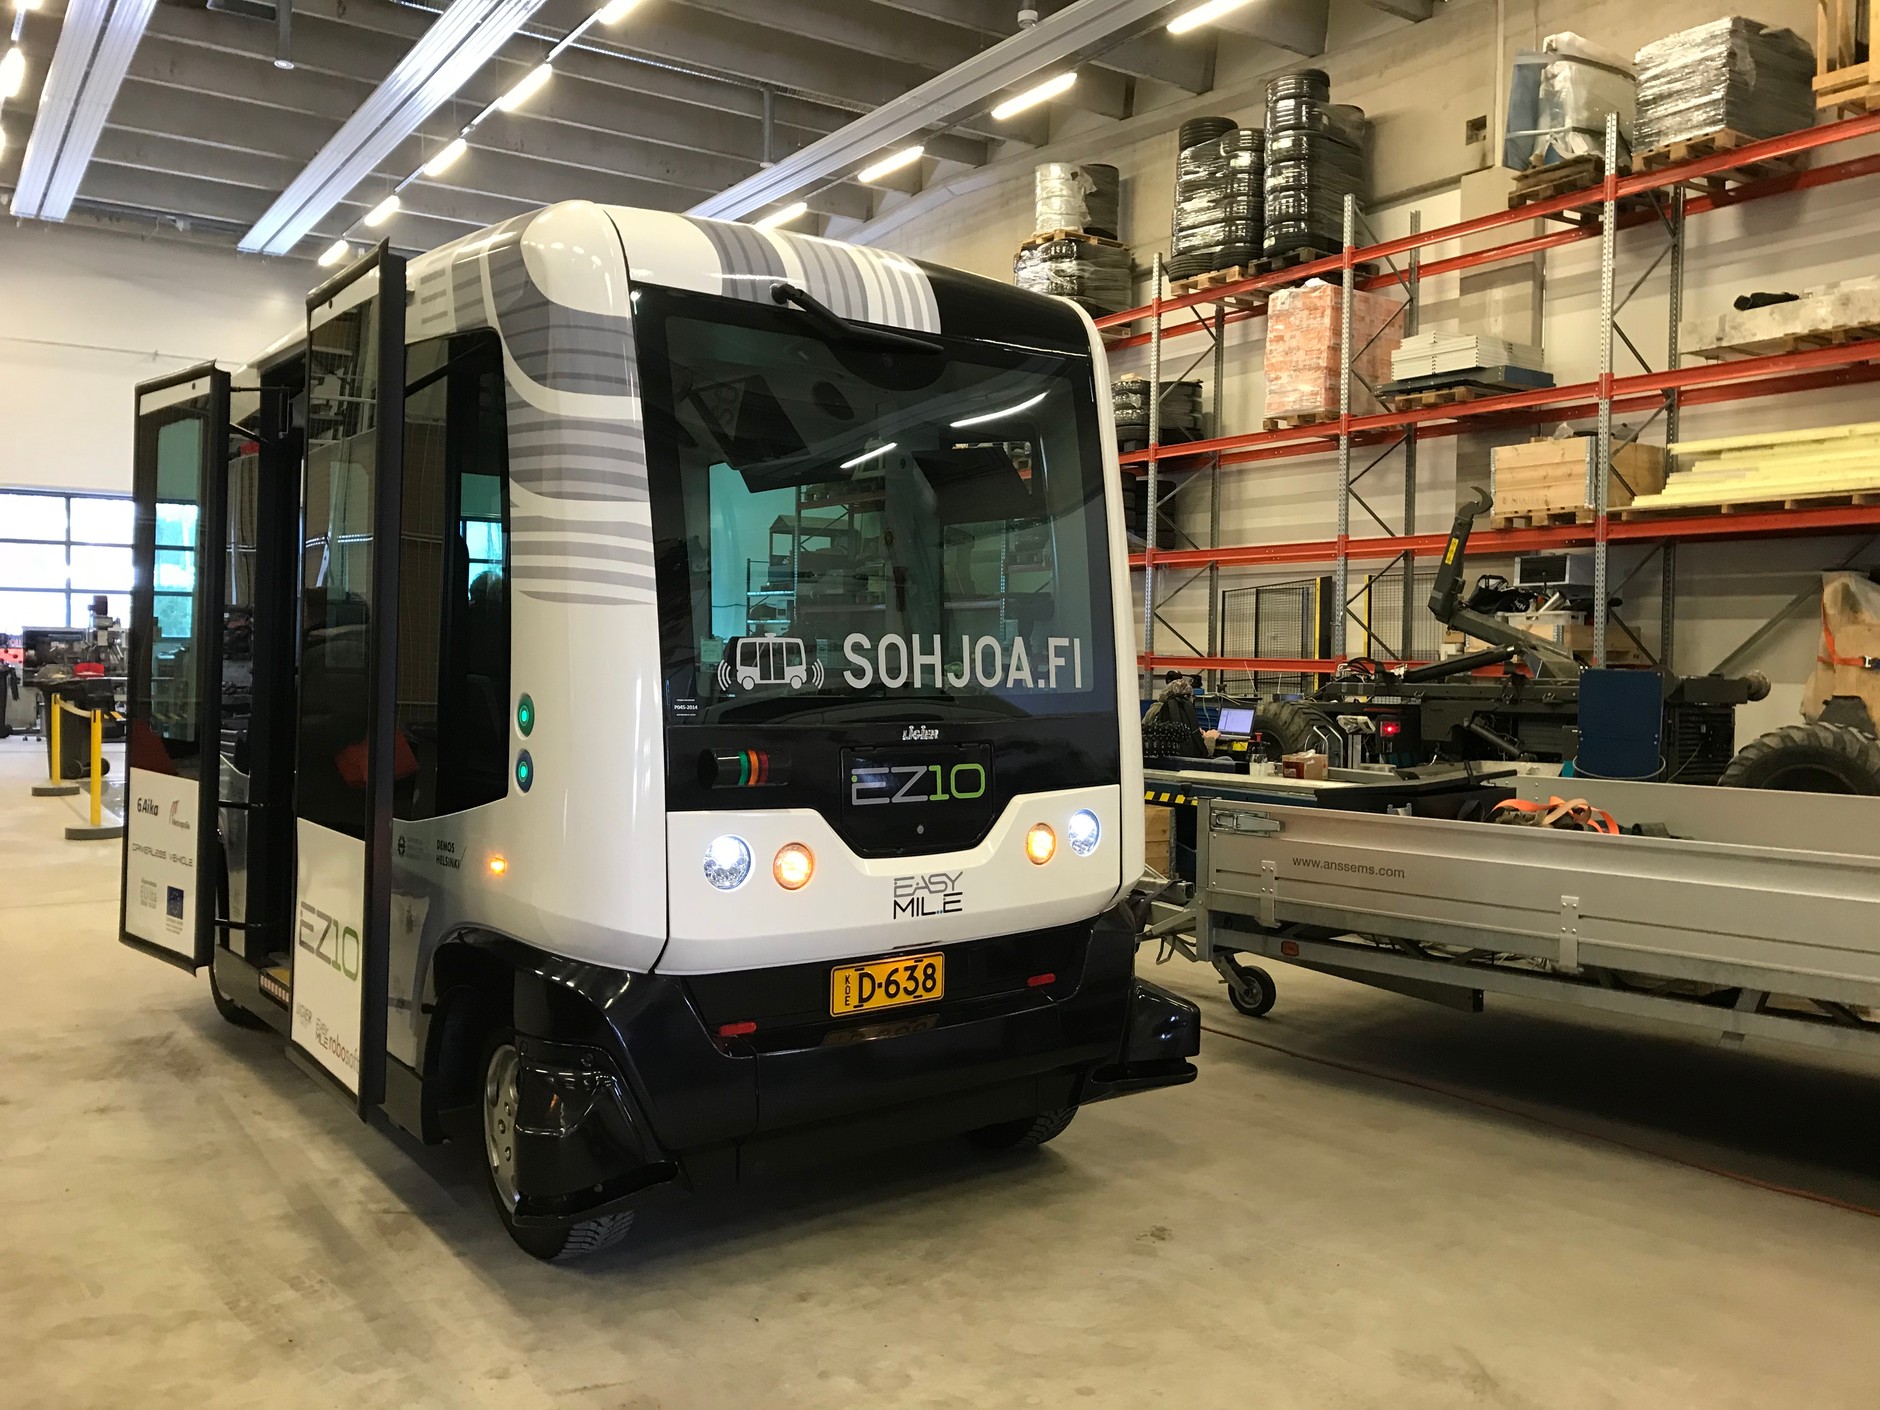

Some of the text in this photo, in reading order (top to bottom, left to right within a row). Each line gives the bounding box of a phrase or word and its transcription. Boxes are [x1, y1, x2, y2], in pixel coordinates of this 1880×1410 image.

[843, 633, 1082, 689] SOHJOA.FI
[851, 763, 986, 806] EZ10
[168, 853, 193, 868] VEHICLE
[436, 839, 455, 853] DEMOS
[435, 854, 460, 870] HELSINKI
[1292, 857, 1405, 879] www.anssems.com
[893, 870, 963, 899] EASY
[299, 901, 360, 982] EZ10
[858, 962, 937, 1004] D-638
